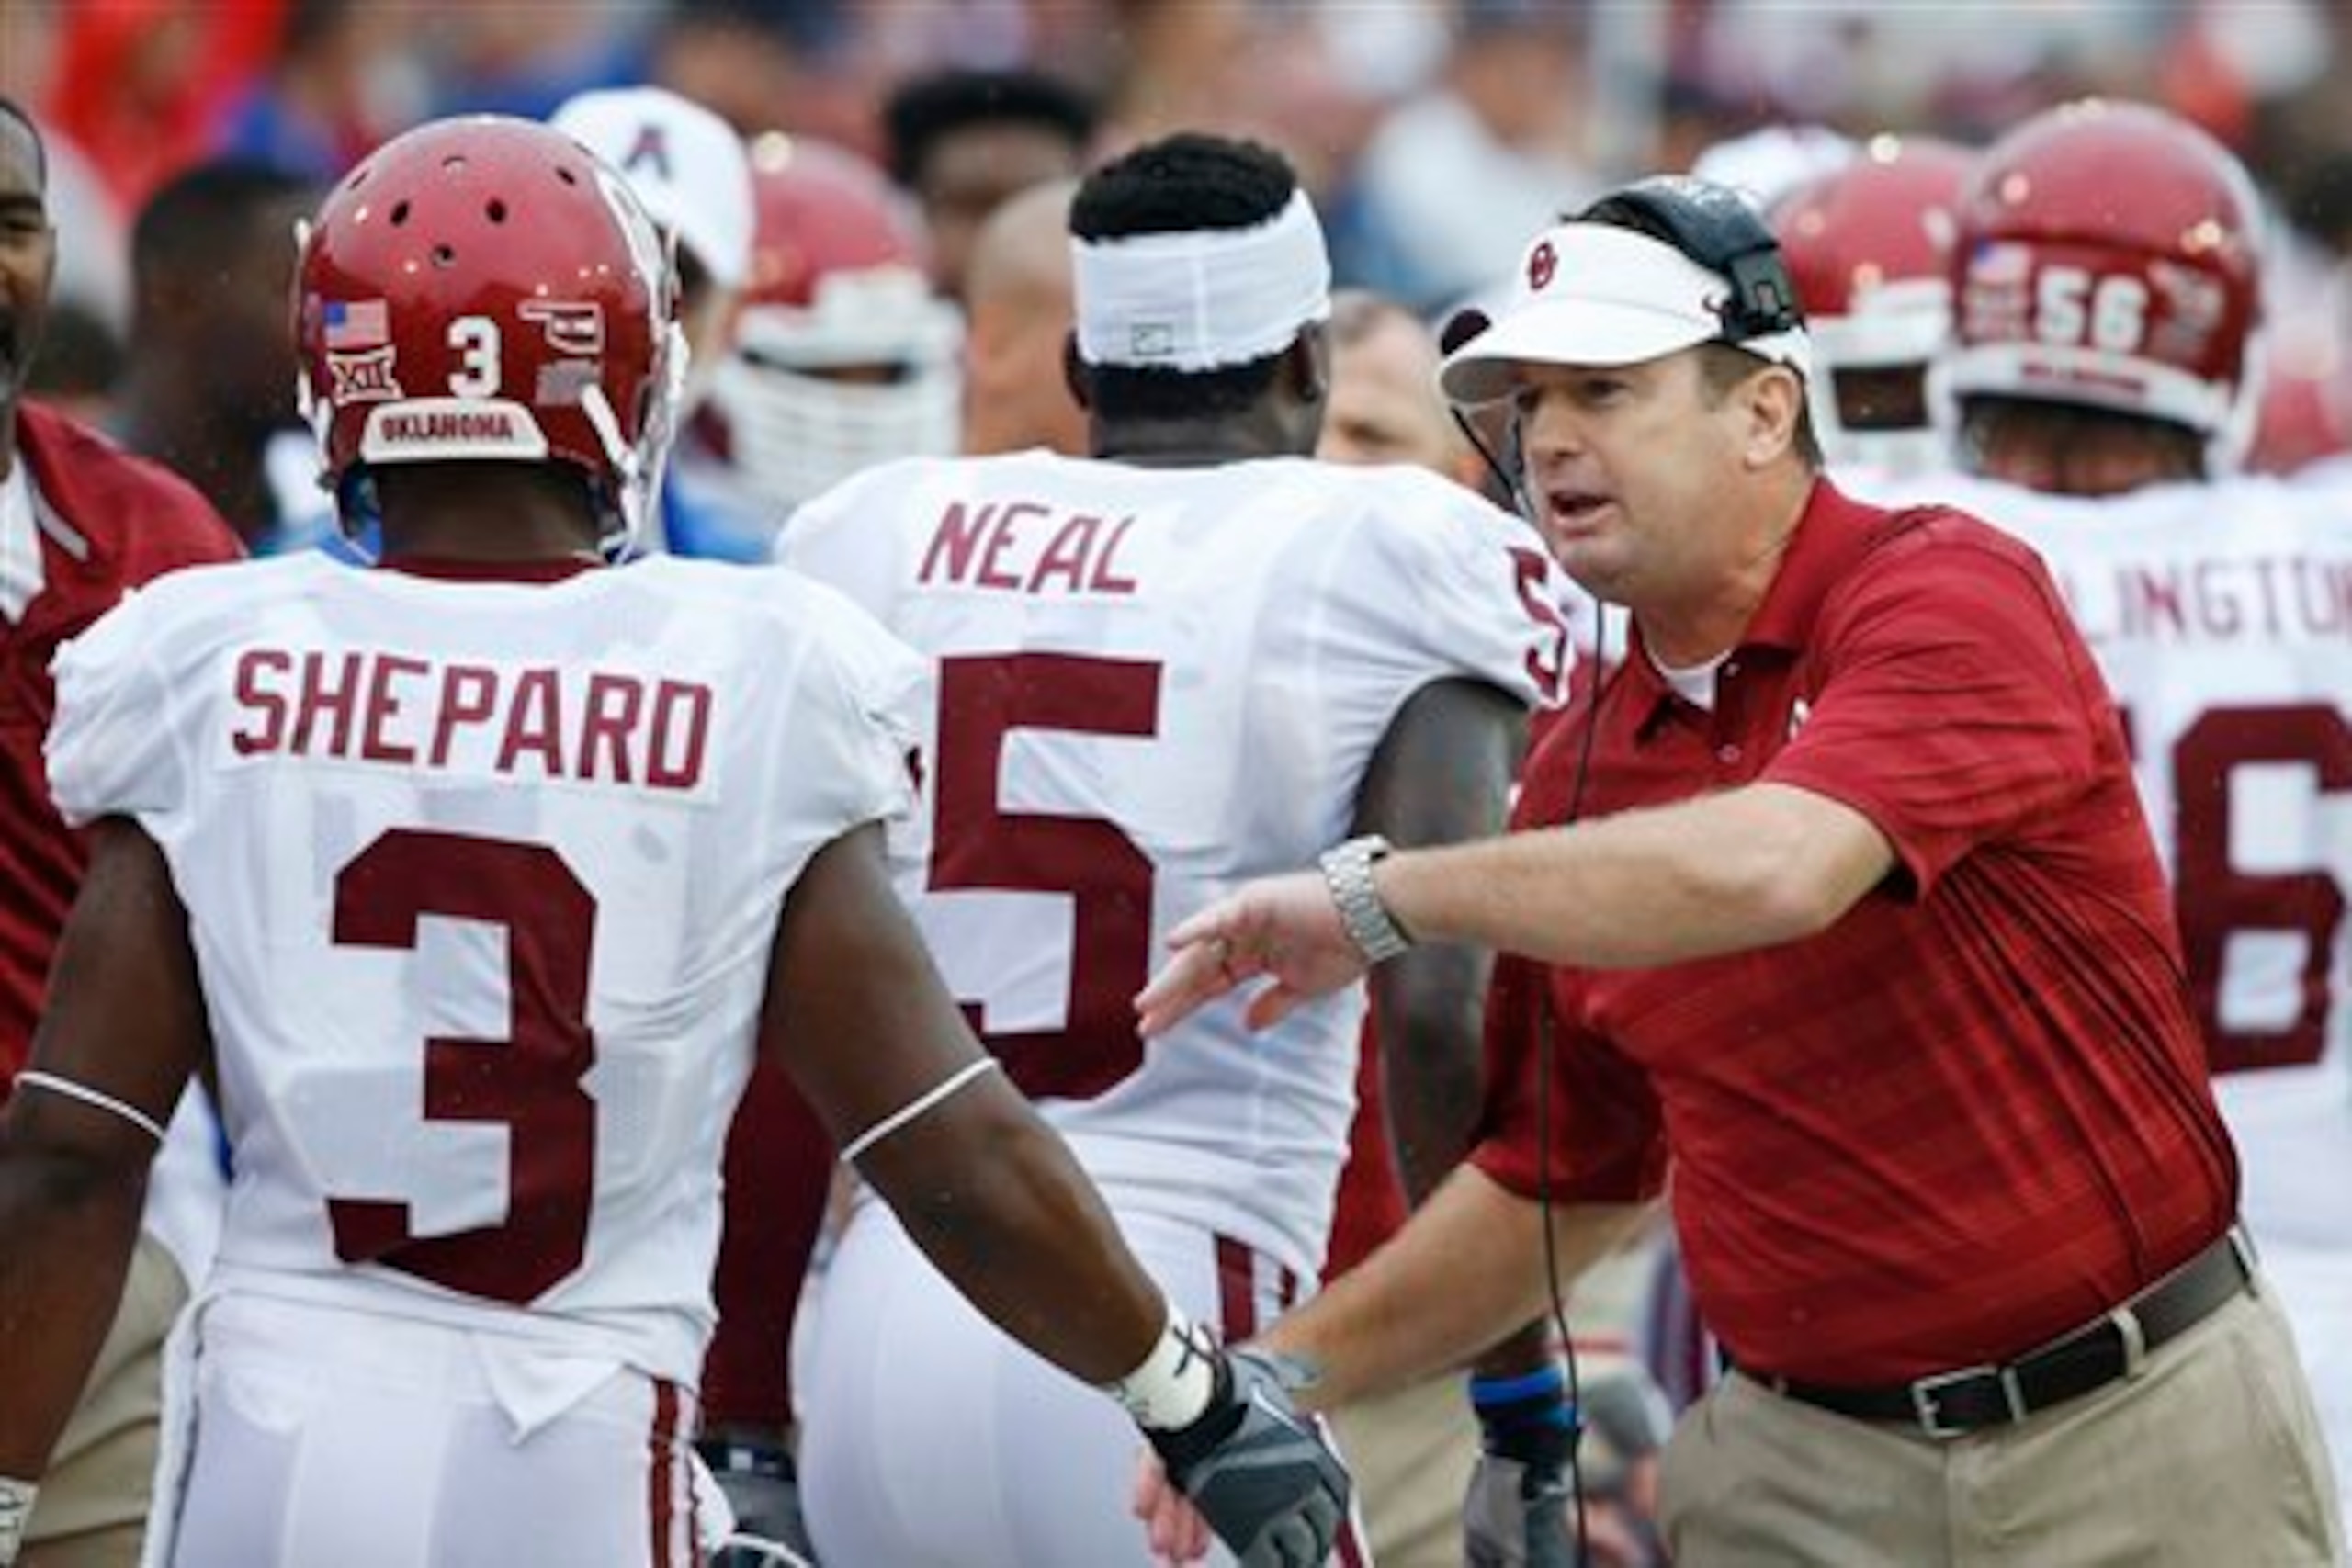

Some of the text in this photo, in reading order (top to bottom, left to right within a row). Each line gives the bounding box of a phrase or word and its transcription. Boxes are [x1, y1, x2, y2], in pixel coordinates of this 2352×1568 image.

[448, 316, 501, 397] 3
[2037, 266, 2148, 354] 56
[380, 413, 514, 442] OKLAHOMA
[919, 502, 1136, 593] NEAL
[232, 649, 713, 790] SHEPARD
[928, 651, 1163, 1102] 5
[2119, 703, 2352, 1073] 6
[326, 828, 598, 1304] 3
